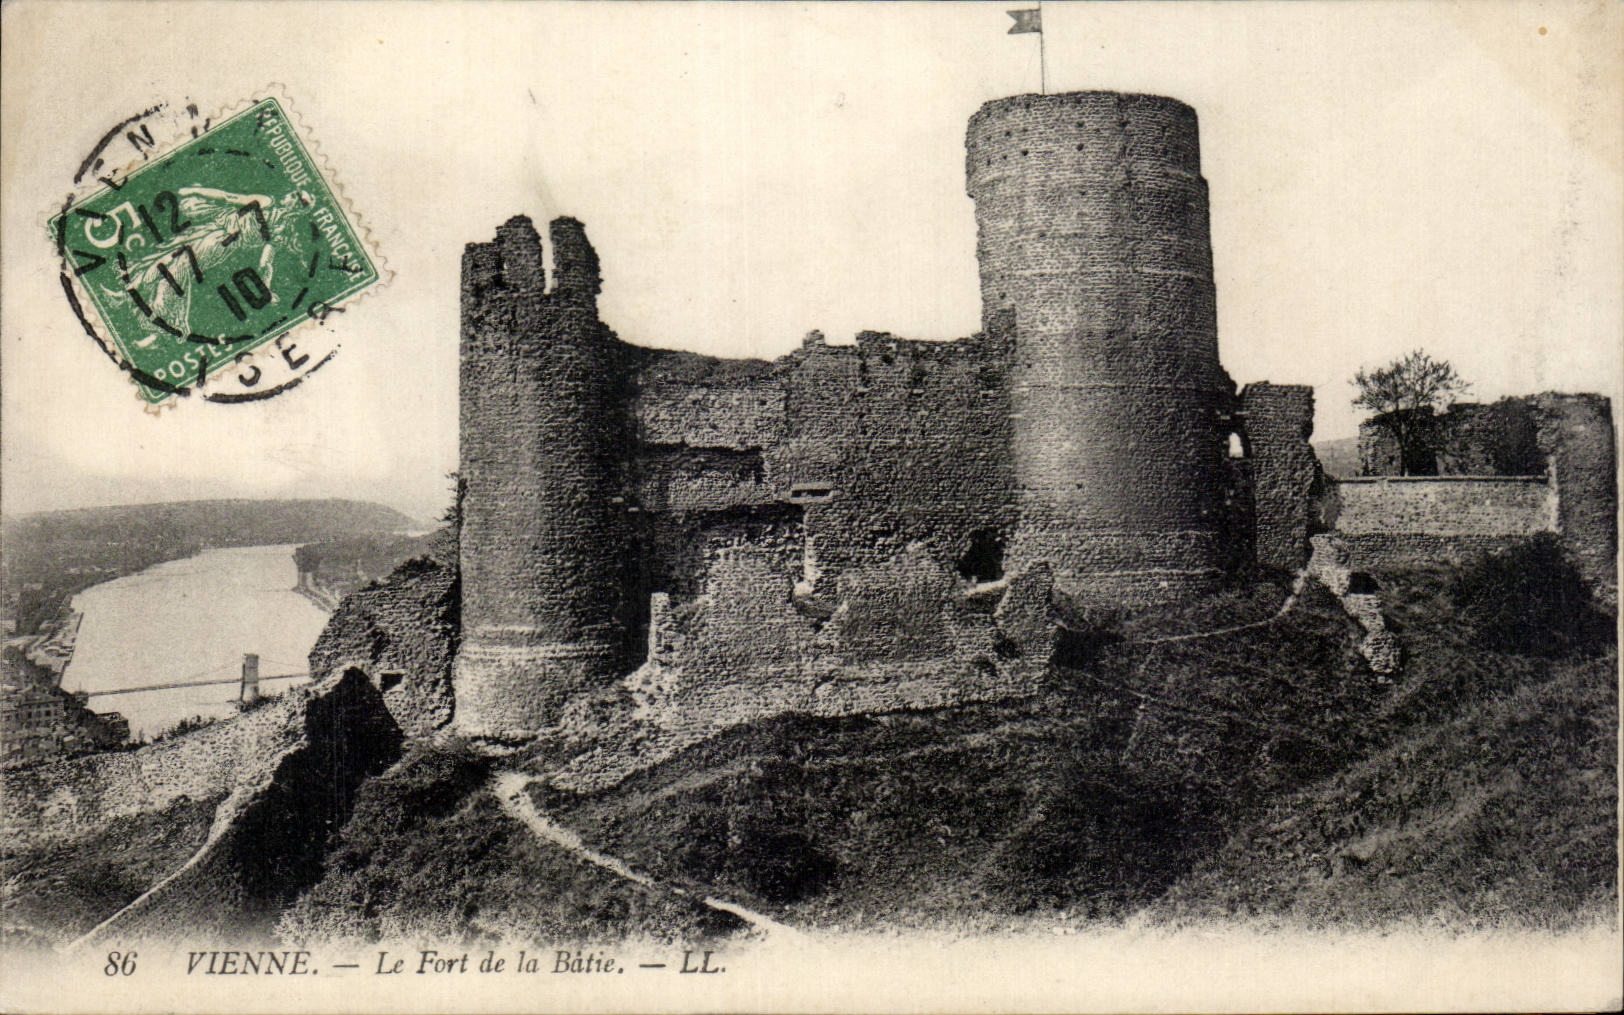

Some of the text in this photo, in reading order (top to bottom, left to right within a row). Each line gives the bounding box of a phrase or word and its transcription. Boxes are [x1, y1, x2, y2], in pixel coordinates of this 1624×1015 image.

[138, 190, 192, 244] 12
[216, 265, 273, 323] 10
[153, 332, 234, 383] POSTES
